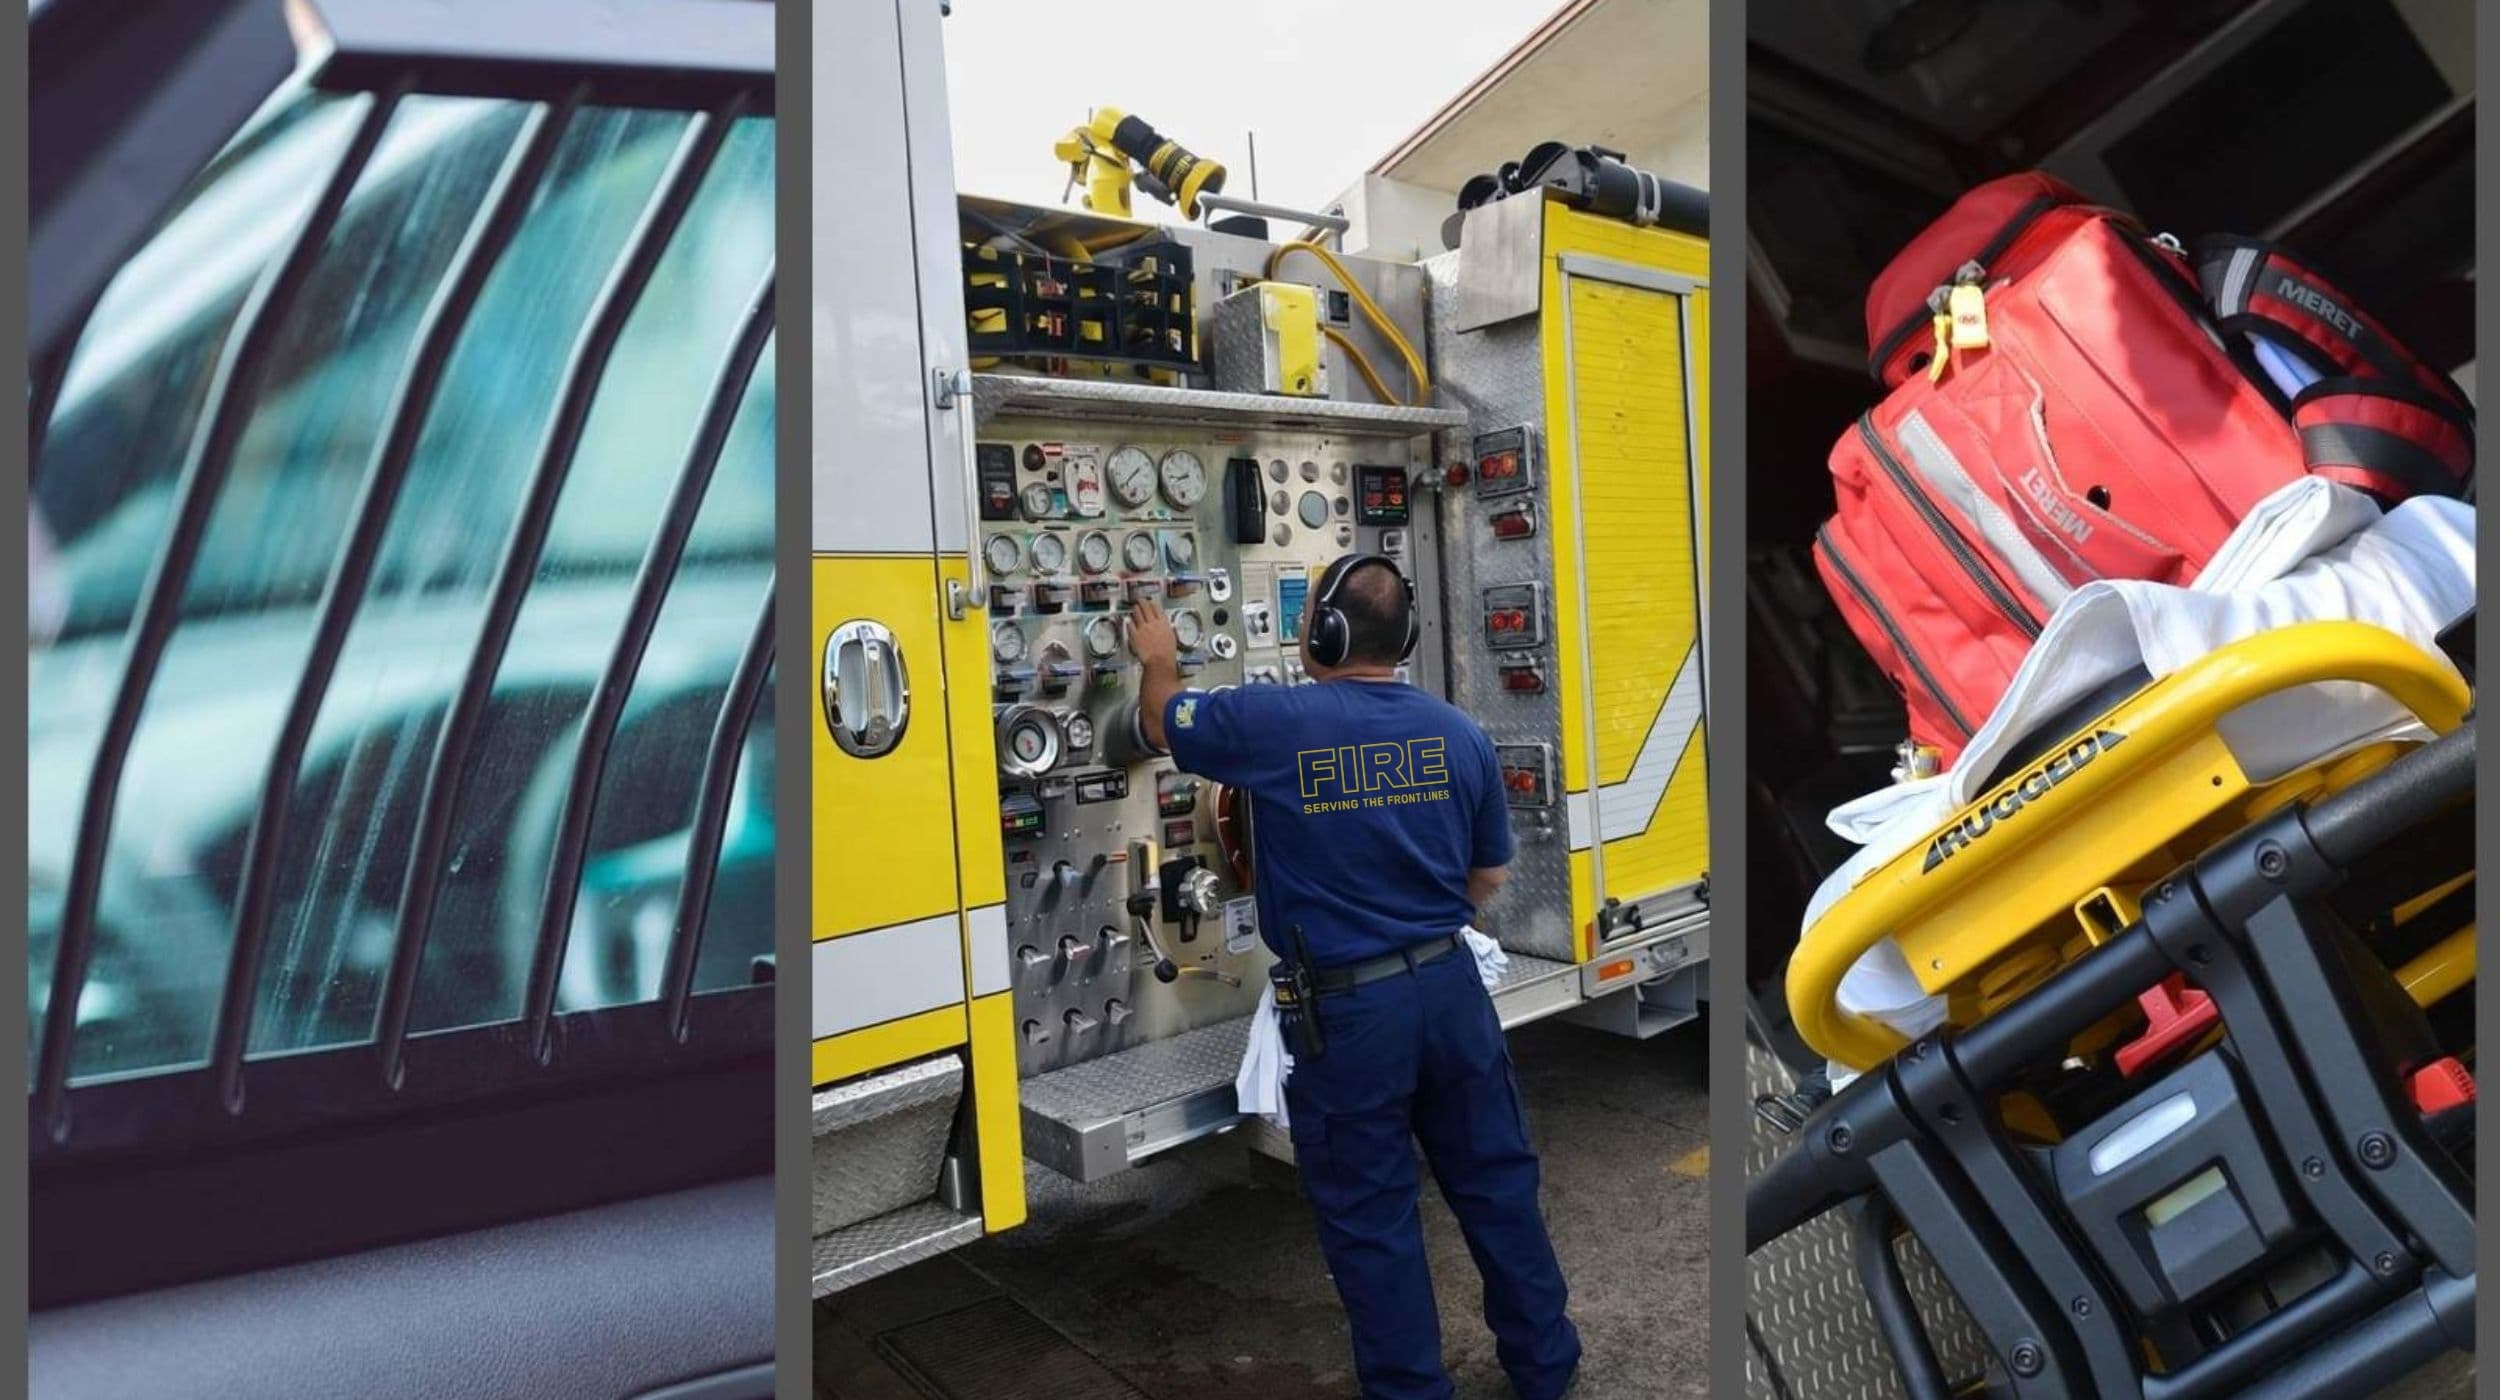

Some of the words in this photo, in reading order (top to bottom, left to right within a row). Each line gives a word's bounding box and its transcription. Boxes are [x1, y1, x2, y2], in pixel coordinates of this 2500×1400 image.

[2277, 278, 2364, 340] MERET
[2018, 467, 2094, 544] MERET
[1297, 736, 1449, 798] FIRE
[1936, 736, 2099, 859] RUGGED
[1303, 799, 1359, 814] SERVING
[1362, 797, 1385, 808] THE
[1387, 792, 1421, 806] FRONT
[1423, 790, 1450, 801] LINES
